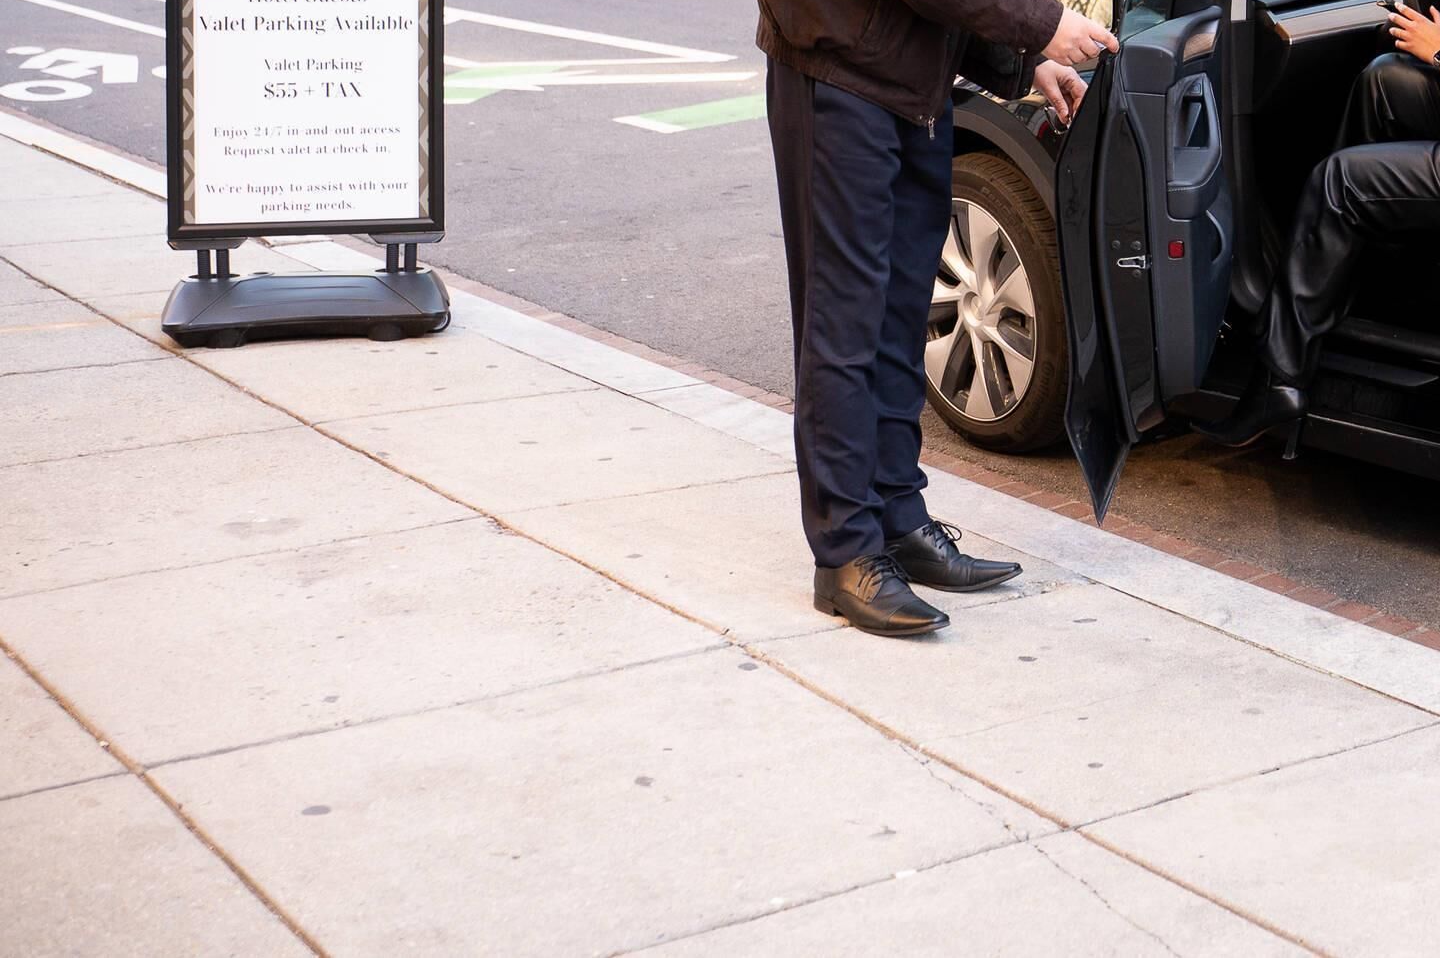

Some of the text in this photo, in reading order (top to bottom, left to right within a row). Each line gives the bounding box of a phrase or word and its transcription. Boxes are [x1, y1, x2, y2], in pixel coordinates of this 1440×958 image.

[200, 15, 413, 34] Valet Parking Available
[265, 57, 363, 73] Valet Parking
[264, 82, 298, 99] $55
[320, 82, 362, 98] TAX
[214, 126, 249, 139] Enjoy
[253, 126, 282, 137] 24/7
[359, 126, 401, 135] access
[224, 146, 275, 158] Request
[281, 145, 310, 155] valet
[315, 146, 327, 155] at
[206, 180, 409, 196] We're happy to assist with your
[260, 198, 355, 214] parking needs.
